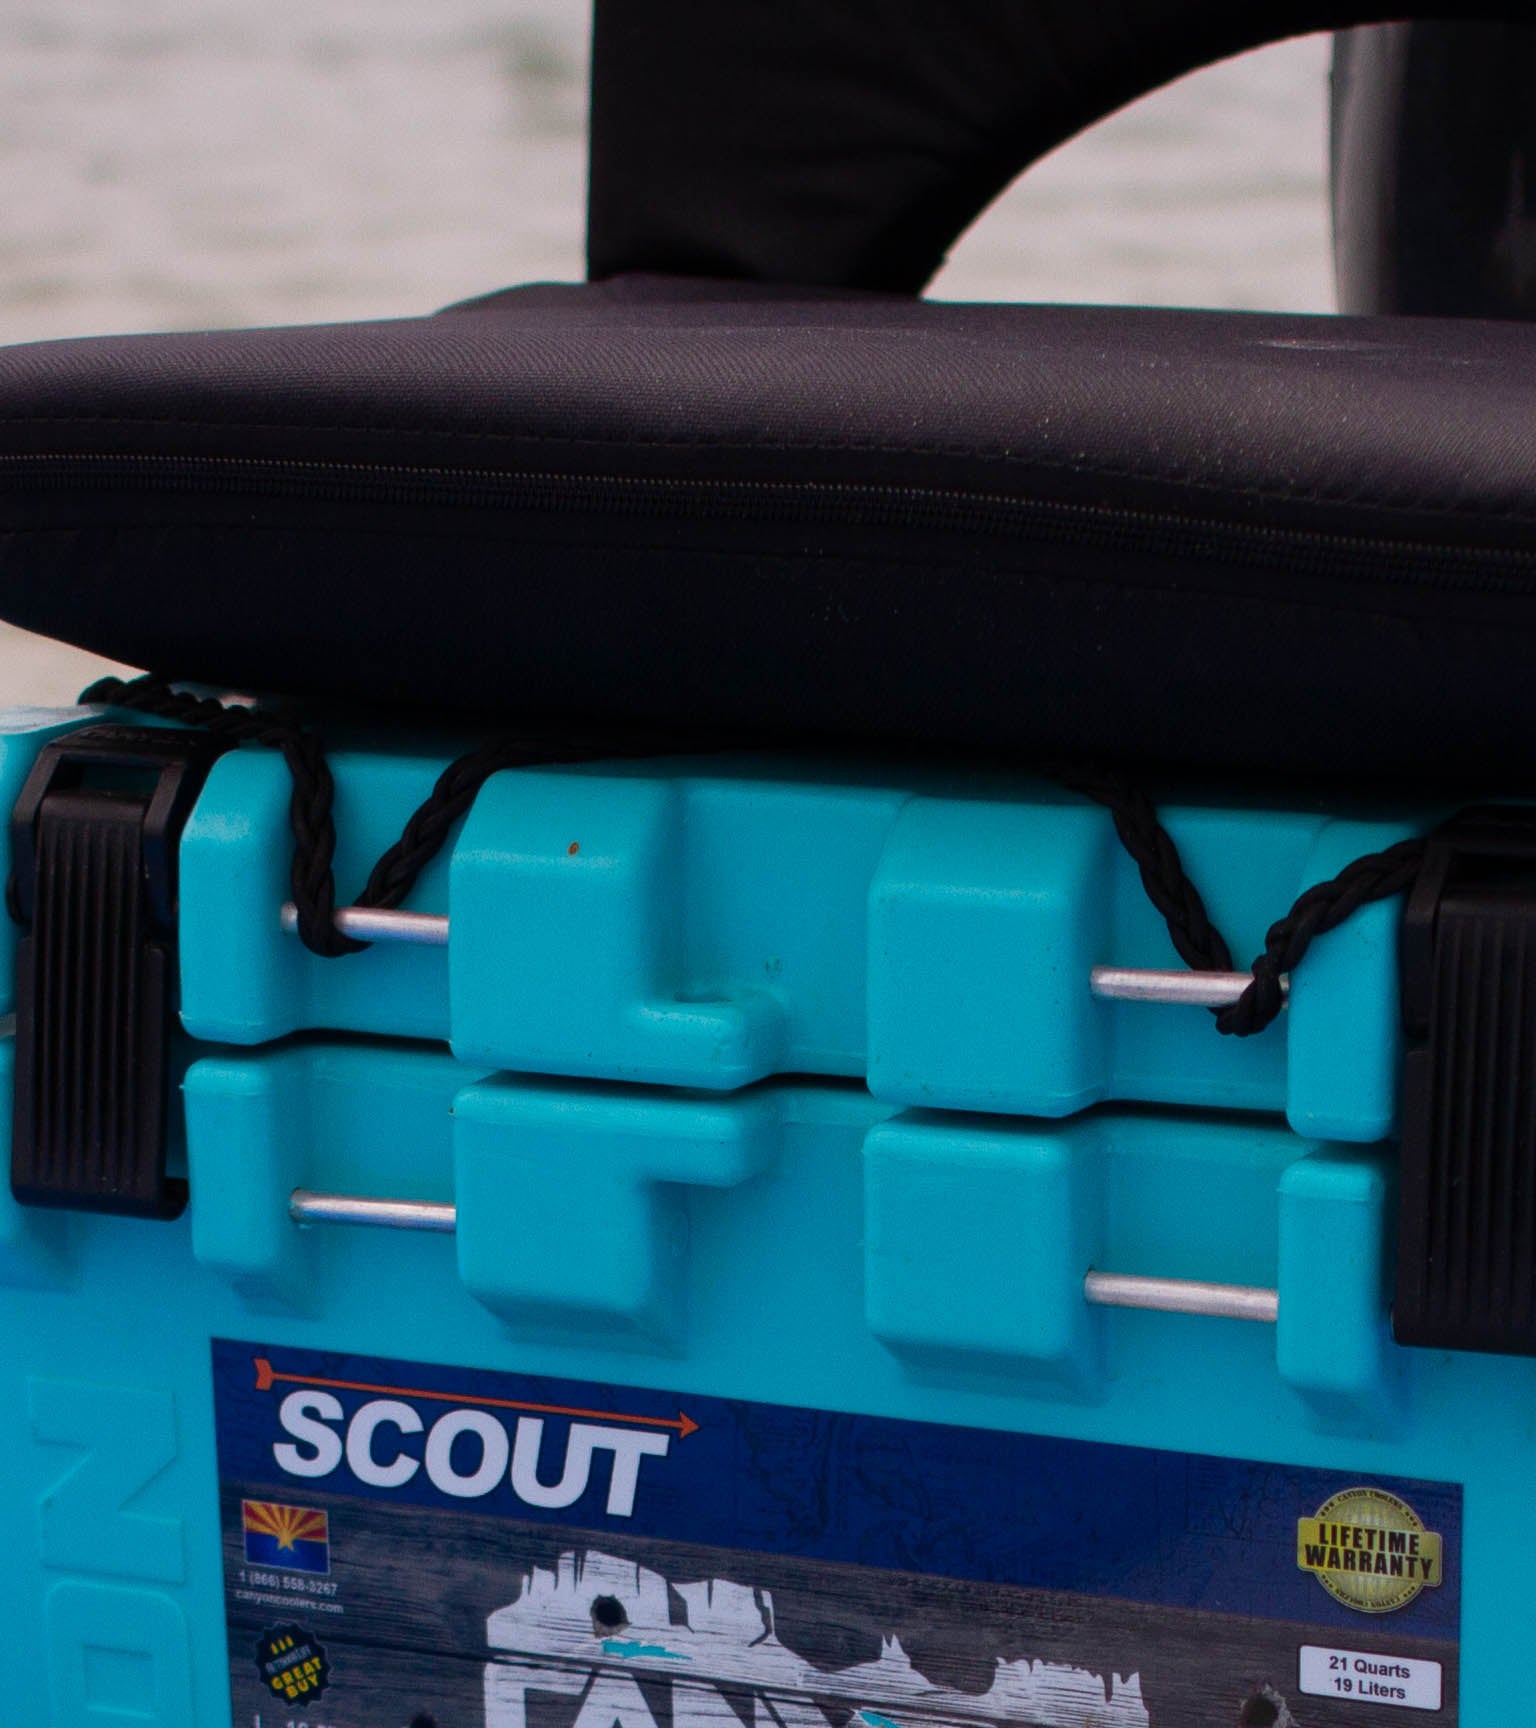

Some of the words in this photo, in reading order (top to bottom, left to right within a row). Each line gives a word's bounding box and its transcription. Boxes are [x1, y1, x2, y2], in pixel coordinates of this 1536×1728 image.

[272, 1389, 670, 1518] SCOUT
[1319, 1523, 1420, 1555] LIFETIME
[1305, 1543, 1434, 1580] WARRANTY
[239, 1569, 246, 1583] 1
[282, 1576, 338, 1597] 558-3267
[271, 1656, 322, 1690] GREAT
[1329, 1655, 1347, 1671] 21
[1354, 1659, 1410, 1679] Quarts
[285, 1673, 319, 1699] BUY
[1334, 1677, 1352, 1692] 19
[1358, 1680, 1406, 1700] Liters
